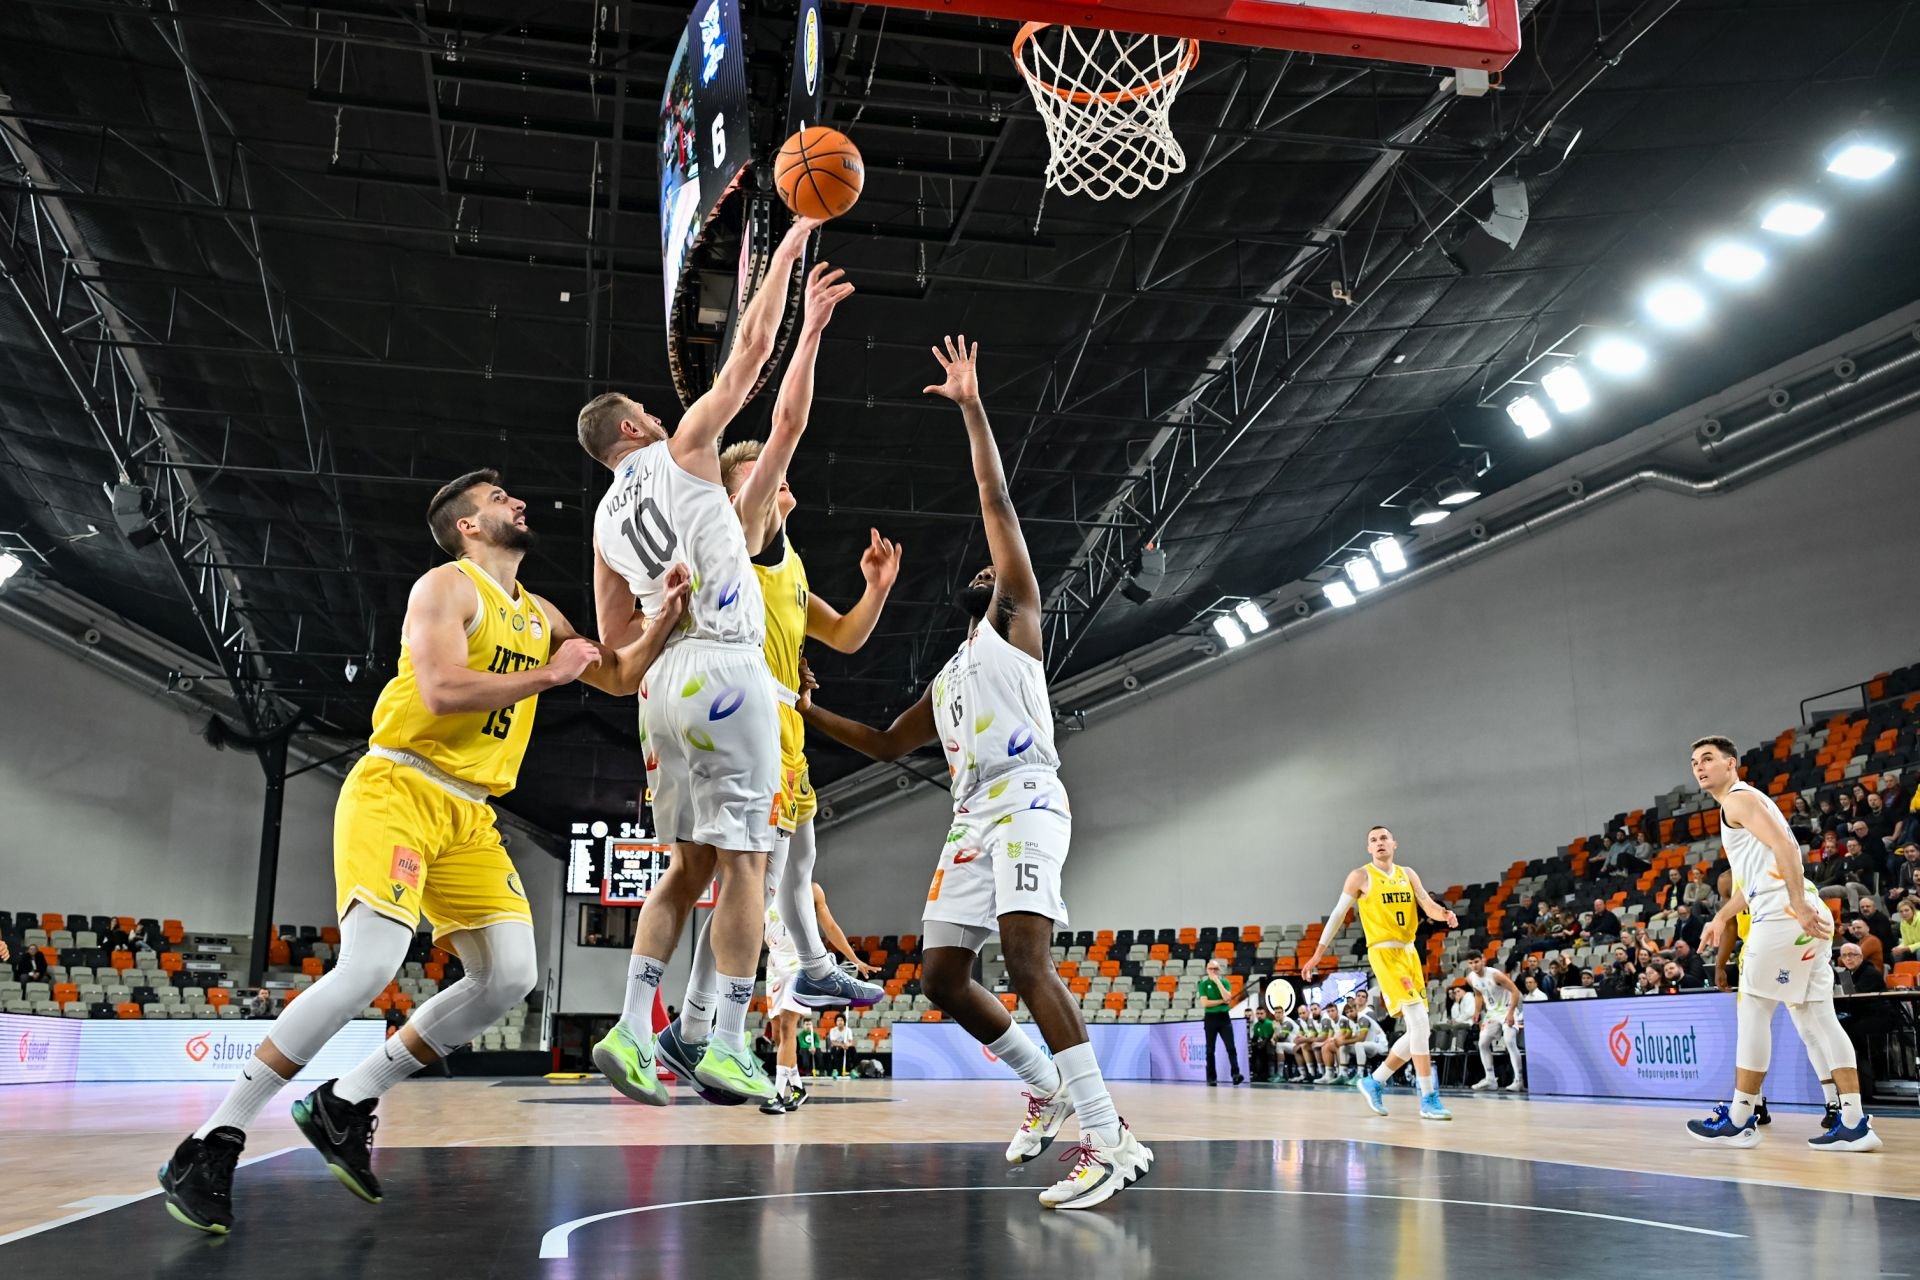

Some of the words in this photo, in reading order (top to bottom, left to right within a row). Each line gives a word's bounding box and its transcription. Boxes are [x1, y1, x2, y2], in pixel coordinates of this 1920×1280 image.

[711, 112, 726, 168] 6
[621, 497, 678, 580] 10
[488, 645, 540, 675] INTE
[481, 703, 516, 740] 15
[950, 695, 963, 728] 15
[1014, 862, 1039, 892] 15
[1381, 891, 1412, 904] INTER
[1395, 911, 1406, 926] 0
[1635, 1021, 1697, 1064] slovanet
[1637, 1068, 1679, 1080] Podporujeme
